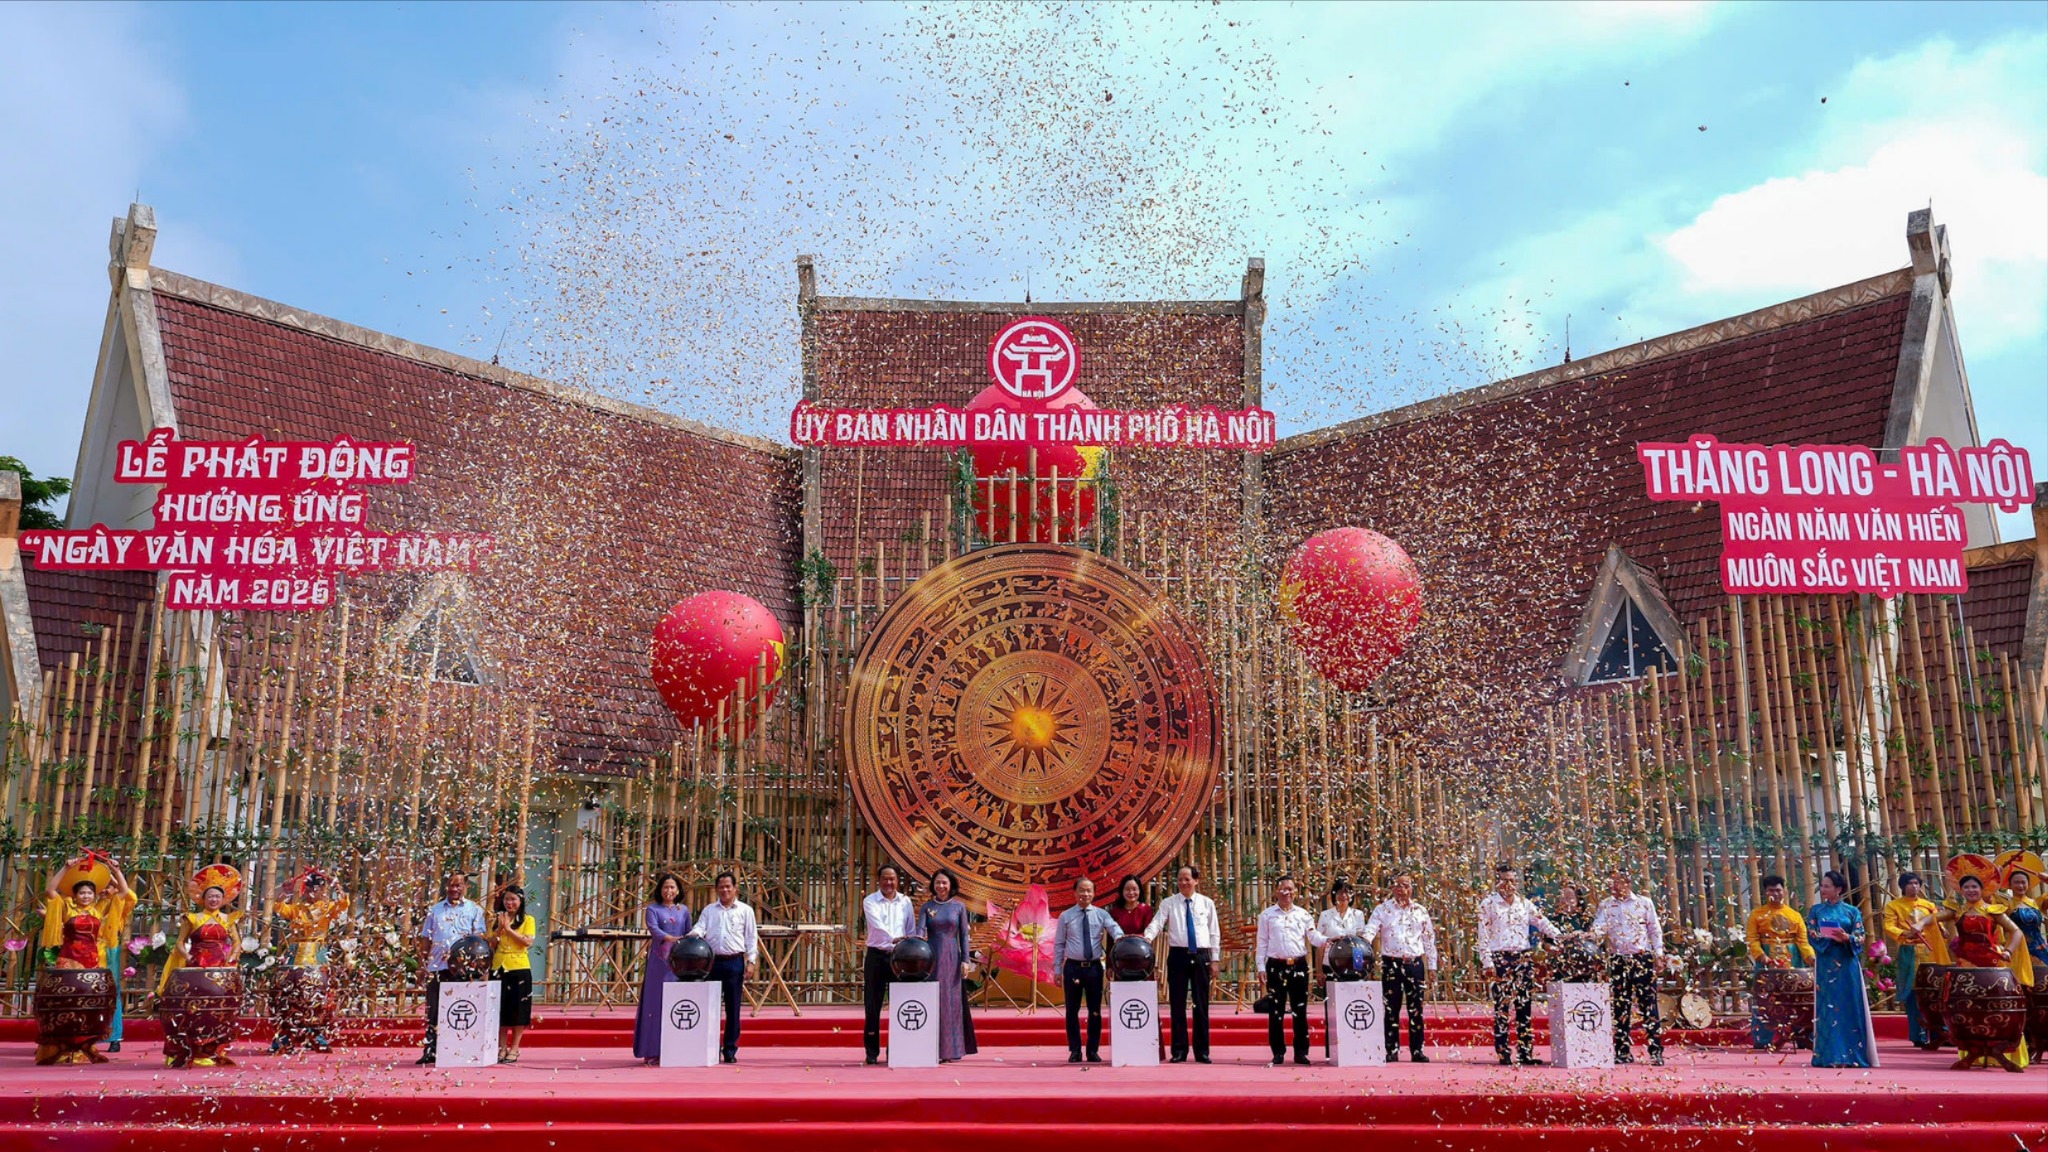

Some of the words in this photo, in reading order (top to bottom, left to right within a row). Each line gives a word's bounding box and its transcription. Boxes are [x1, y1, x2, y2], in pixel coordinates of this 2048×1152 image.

[796, 405, 829, 441] ỦY
[836, 413, 888, 441] BAN
[896, 407, 966, 441] NHÂN
[974, 408, 1026, 441] DÂN
[1033, 407, 1120, 441] THÀNH
[1128, 407, 1181, 442] PHỐ
[1186, 408, 1221, 443] HÀ
[1228, 410, 1270, 449] NỘI
[120, 433, 168, 478] LỄ
[181, 440, 287, 479] PHÁT
[299, 440, 409, 486] ĐỘNG
[1643, 440, 1769, 494] THĂNG
[1778, 451, 1873, 496] LONG
[1883, 469, 1898, 478] -
[1907, 444, 1960, 497] HÀ
[1969, 446, 2030, 507] NỘI
[158, 486, 281, 522] HƯỞNG
[293, 487, 363, 523] ỨNG
[1727, 507, 1793, 541] NGÀN
[1797, 507, 1851, 541] NĂM
[1854, 507, 1900, 541] VĂN
[1908, 504, 1962, 542] HIẾN
[145, 530, 214, 564] VĂN
[223, 530, 298, 565] HÓA
[173, 573, 239, 604] NĂM
[251, 579, 329, 605] 2026
[1727, 552, 1797, 587] MUÔN
[1802, 547, 1847, 587] SẮC
[1851, 552, 1901, 592] VIỆT
[1908, 558, 1962, 587] NAM
